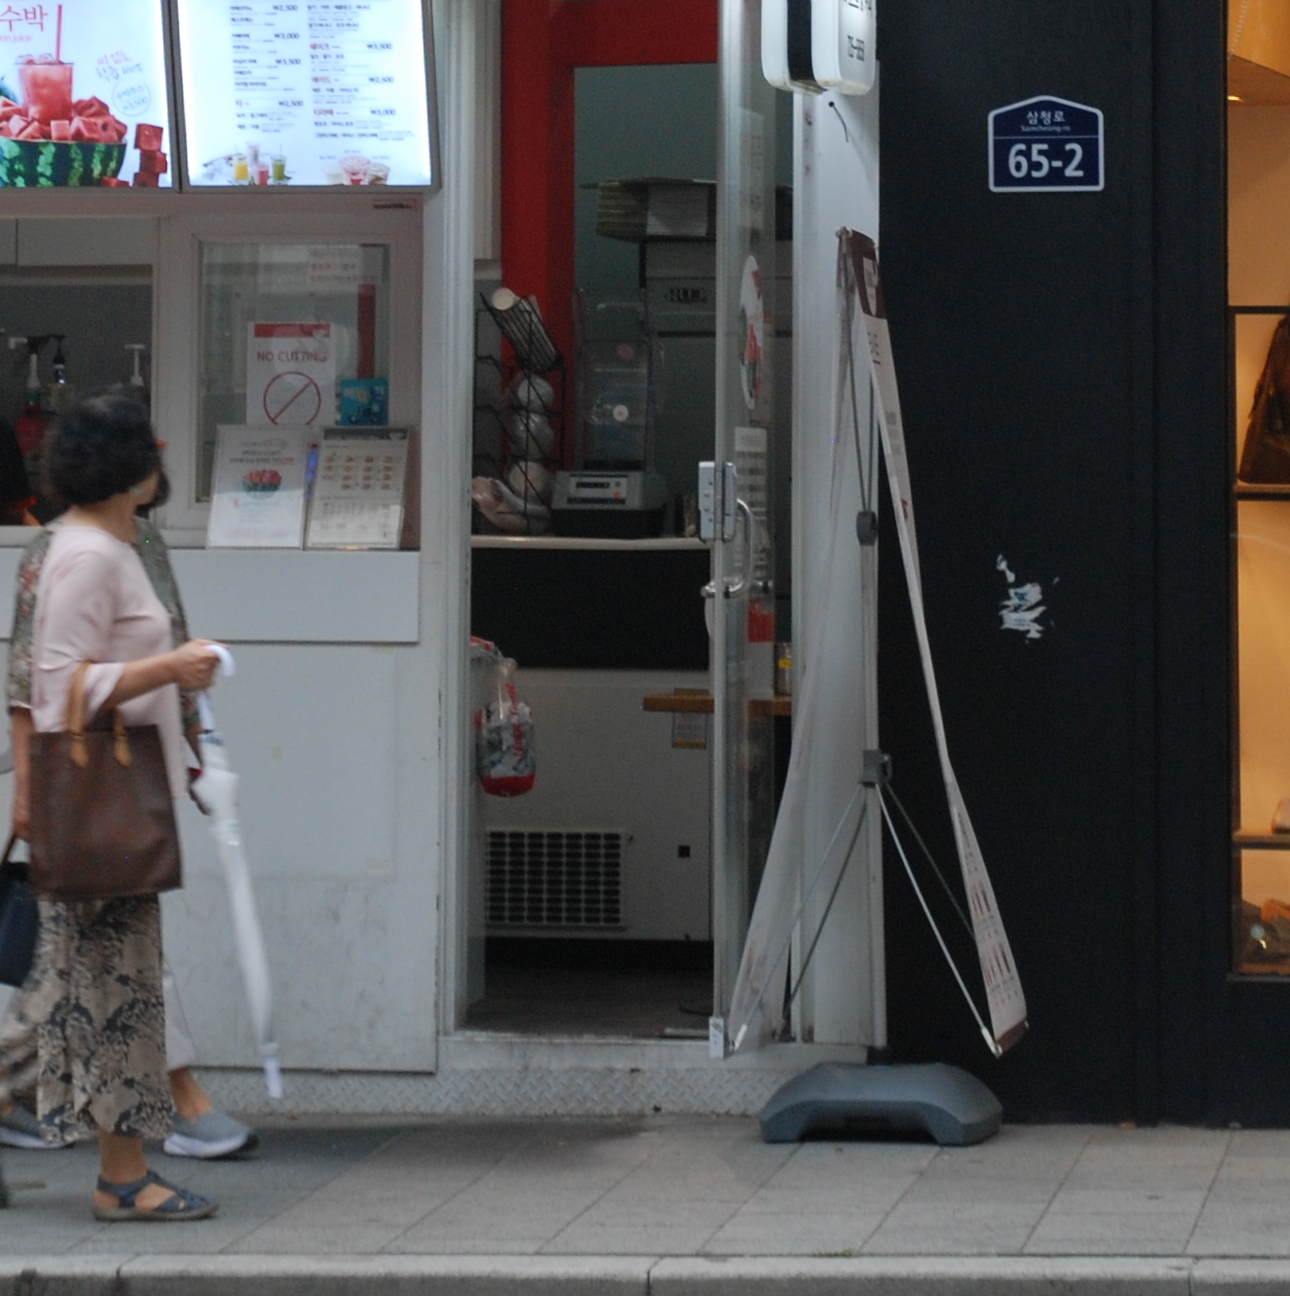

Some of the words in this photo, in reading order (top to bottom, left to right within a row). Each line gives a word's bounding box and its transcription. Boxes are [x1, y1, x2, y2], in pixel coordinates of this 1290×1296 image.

[1026, 110, 1066, 125] 삼청로
[1008, 142, 1085, 178] 65-2
[257, 351, 274, 362] NO
